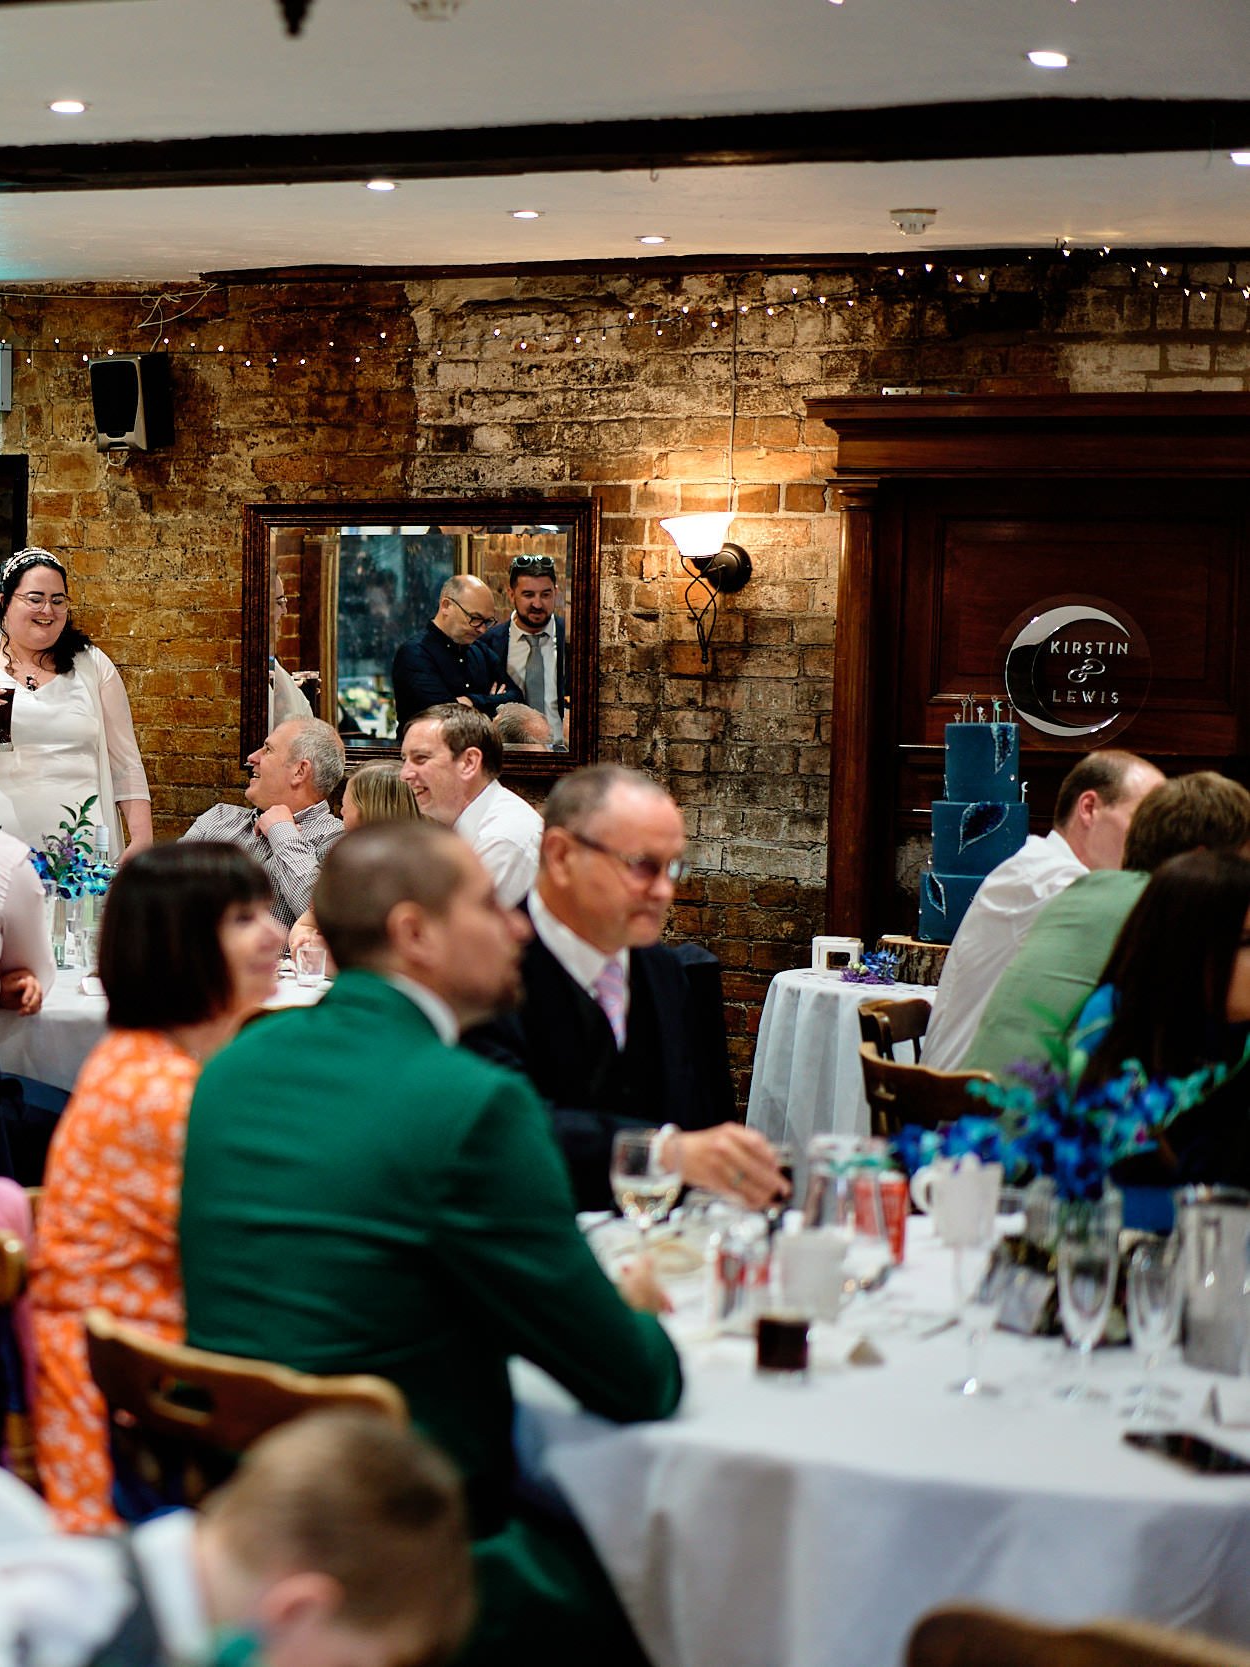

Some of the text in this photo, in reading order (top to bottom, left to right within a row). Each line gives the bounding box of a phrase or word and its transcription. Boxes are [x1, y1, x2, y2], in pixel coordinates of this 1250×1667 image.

[1050, 641, 1128, 654] KIRSTIN
[1068, 658, 1105, 683] &
[1052, 690, 1119, 704] LEWIS
